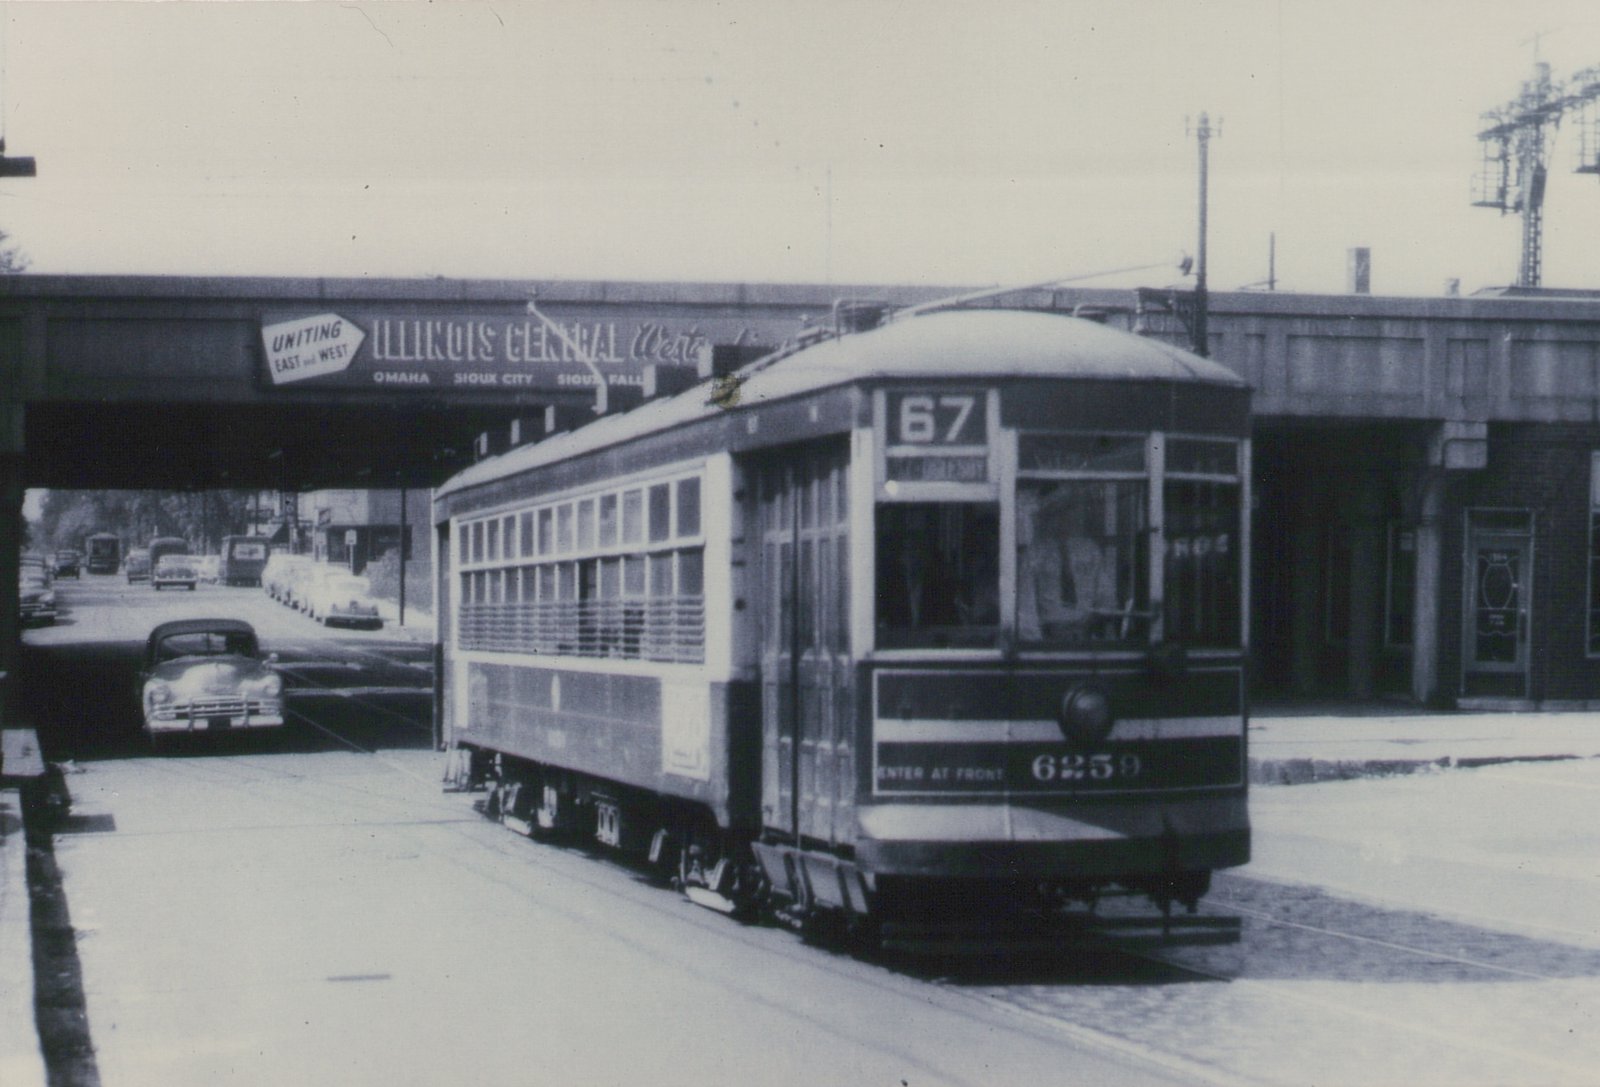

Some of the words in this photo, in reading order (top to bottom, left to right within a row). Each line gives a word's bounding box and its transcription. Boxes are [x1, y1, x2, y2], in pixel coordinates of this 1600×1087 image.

[272, 319, 342, 353] UNITING
[372, 320, 496, 361] ILLINOIS
[506, 321, 624, 362] CENTRAL
[275, 355, 300, 373] EAST
[318, 343, 348, 361] WEST
[373, 371, 429, 385] OMAHA
[453, 371, 497, 385] SIOUX
[502, 373, 533, 385] CITY
[557, 373, 602, 385] SIOUX
[608, 373, 644, 385] FALL
[899, 396, 975, 442] 67
[876, 766, 924, 780] ENTER
[930, 768, 949, 780] AT
[957, 768, 1004, 781] FRONT
